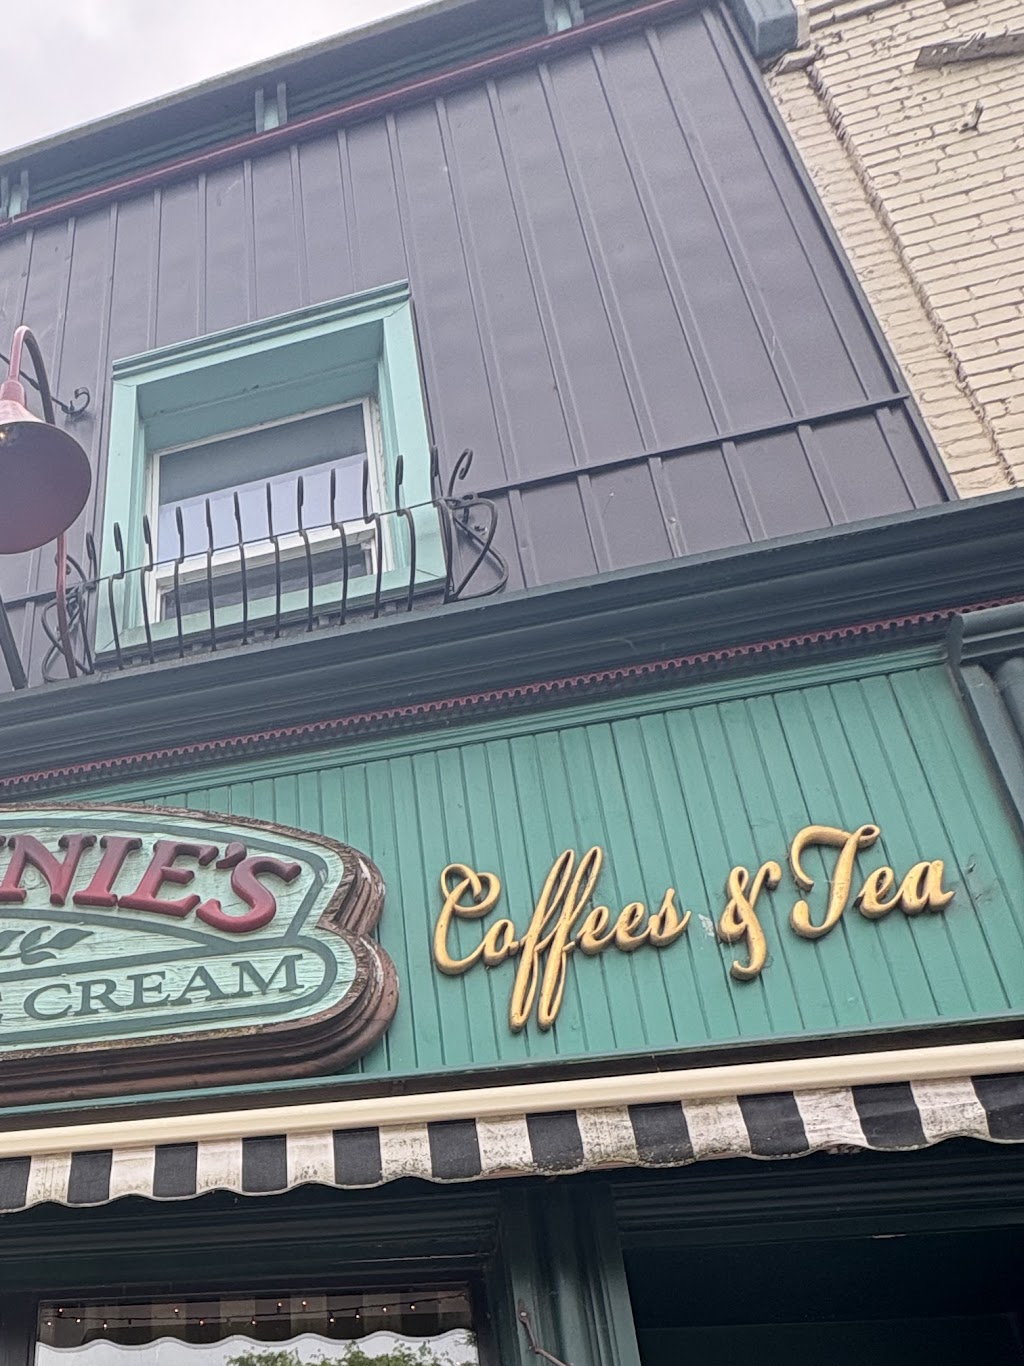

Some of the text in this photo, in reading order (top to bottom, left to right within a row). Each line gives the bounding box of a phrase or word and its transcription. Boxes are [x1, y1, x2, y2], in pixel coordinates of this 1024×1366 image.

[22, 953, 306, 1019] CREAM
[433, 823, 956, 1033] Coffees & Tea
